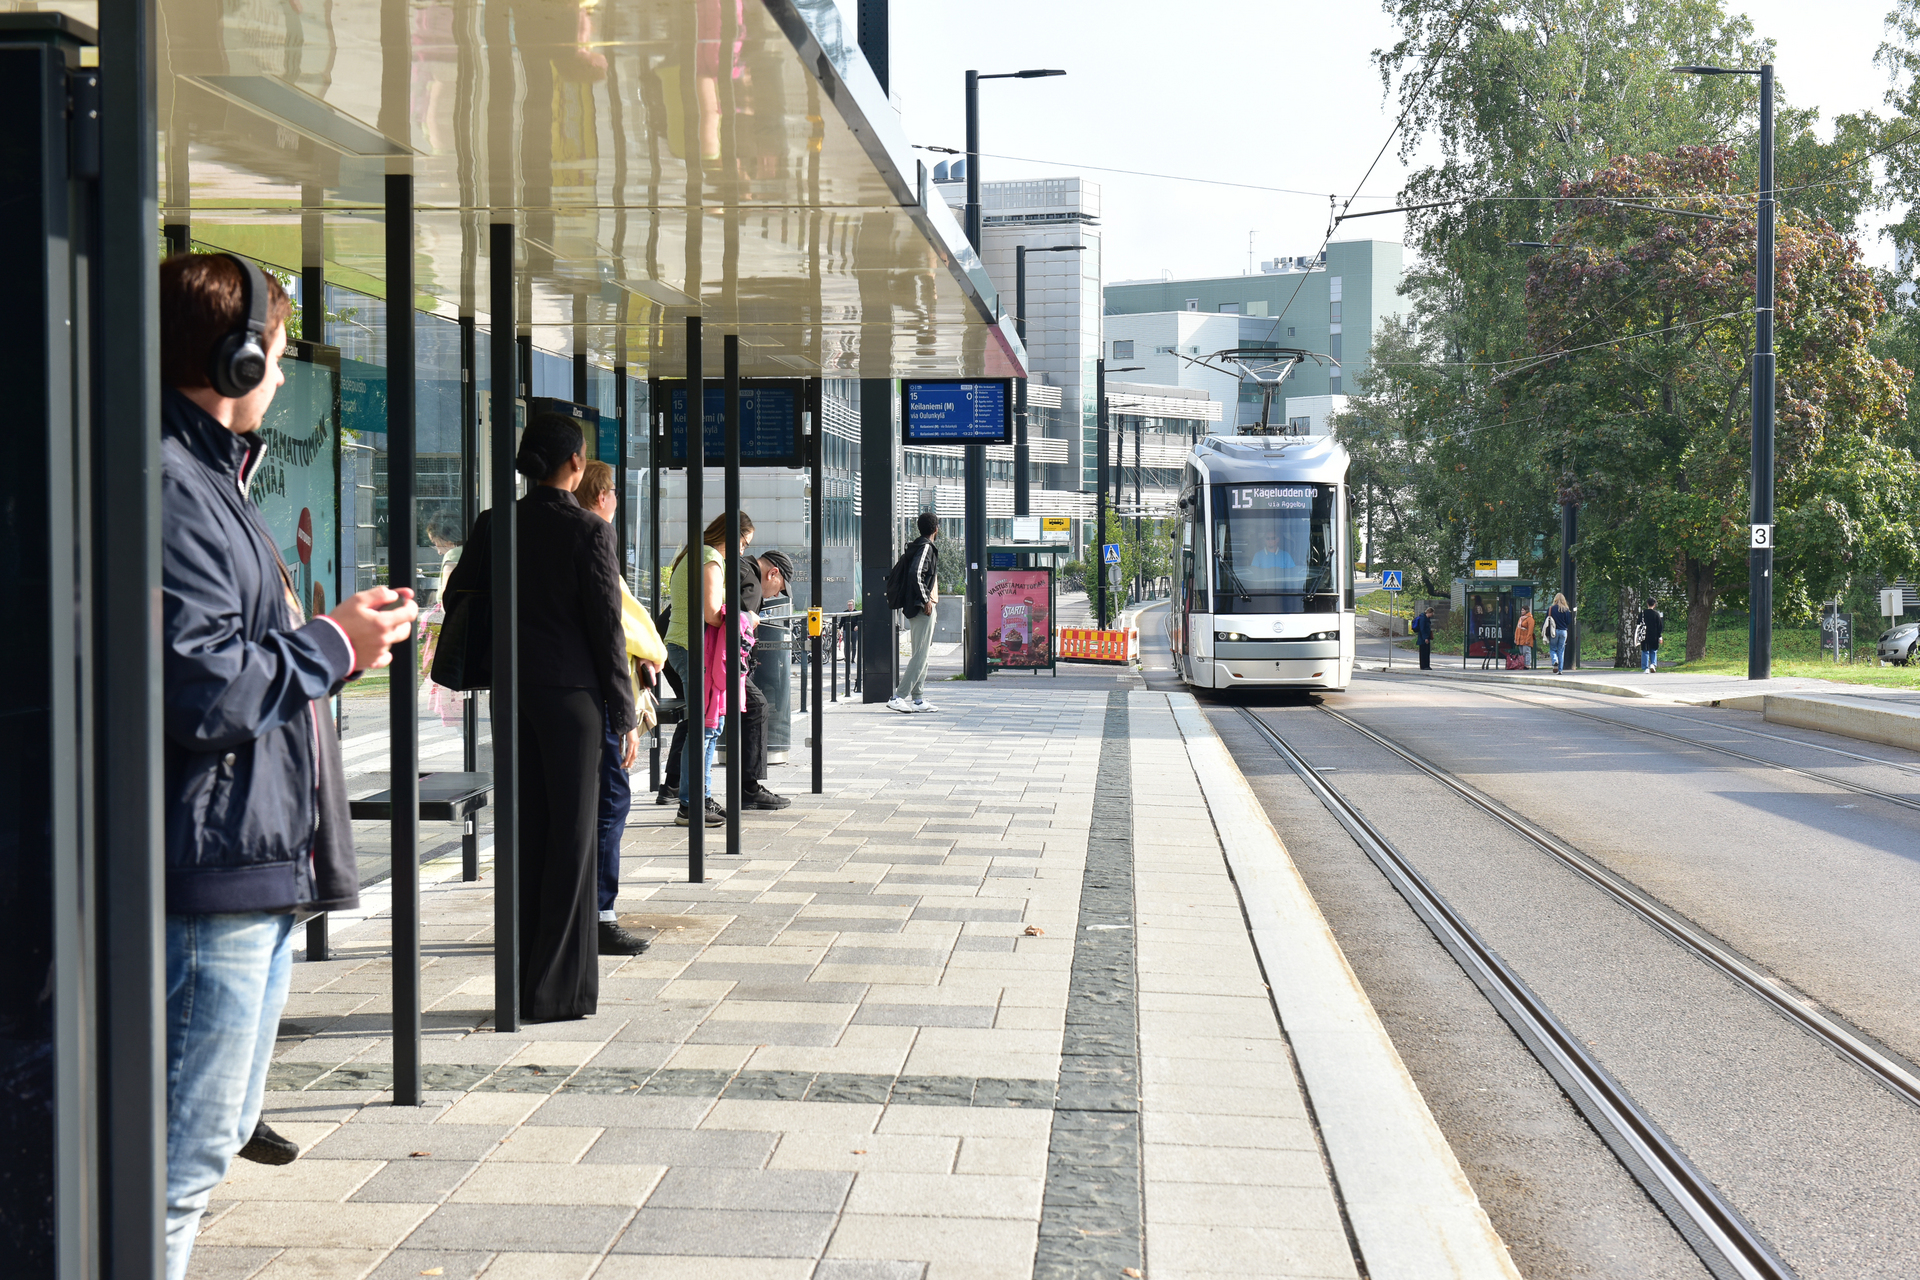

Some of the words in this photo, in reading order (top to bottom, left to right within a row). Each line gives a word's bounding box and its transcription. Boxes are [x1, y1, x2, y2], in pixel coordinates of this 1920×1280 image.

[285, 345, 298, 357] ecaux
[673, 400, 683, 410] 15
[944, 402, 954, 412] (M)
[920, 412, 946, 420] Oulunkylä
[261, 414, 328, 468] STAMATTOMAN
[1232, 489, 1253, 508] 15
[1254, 488, 1303, 499] Kägeludden
[1304, 488, 1318, 498] (M)
[1754, 528, 1766, 544] 3
[1003, 606, 1026, 618] START!
